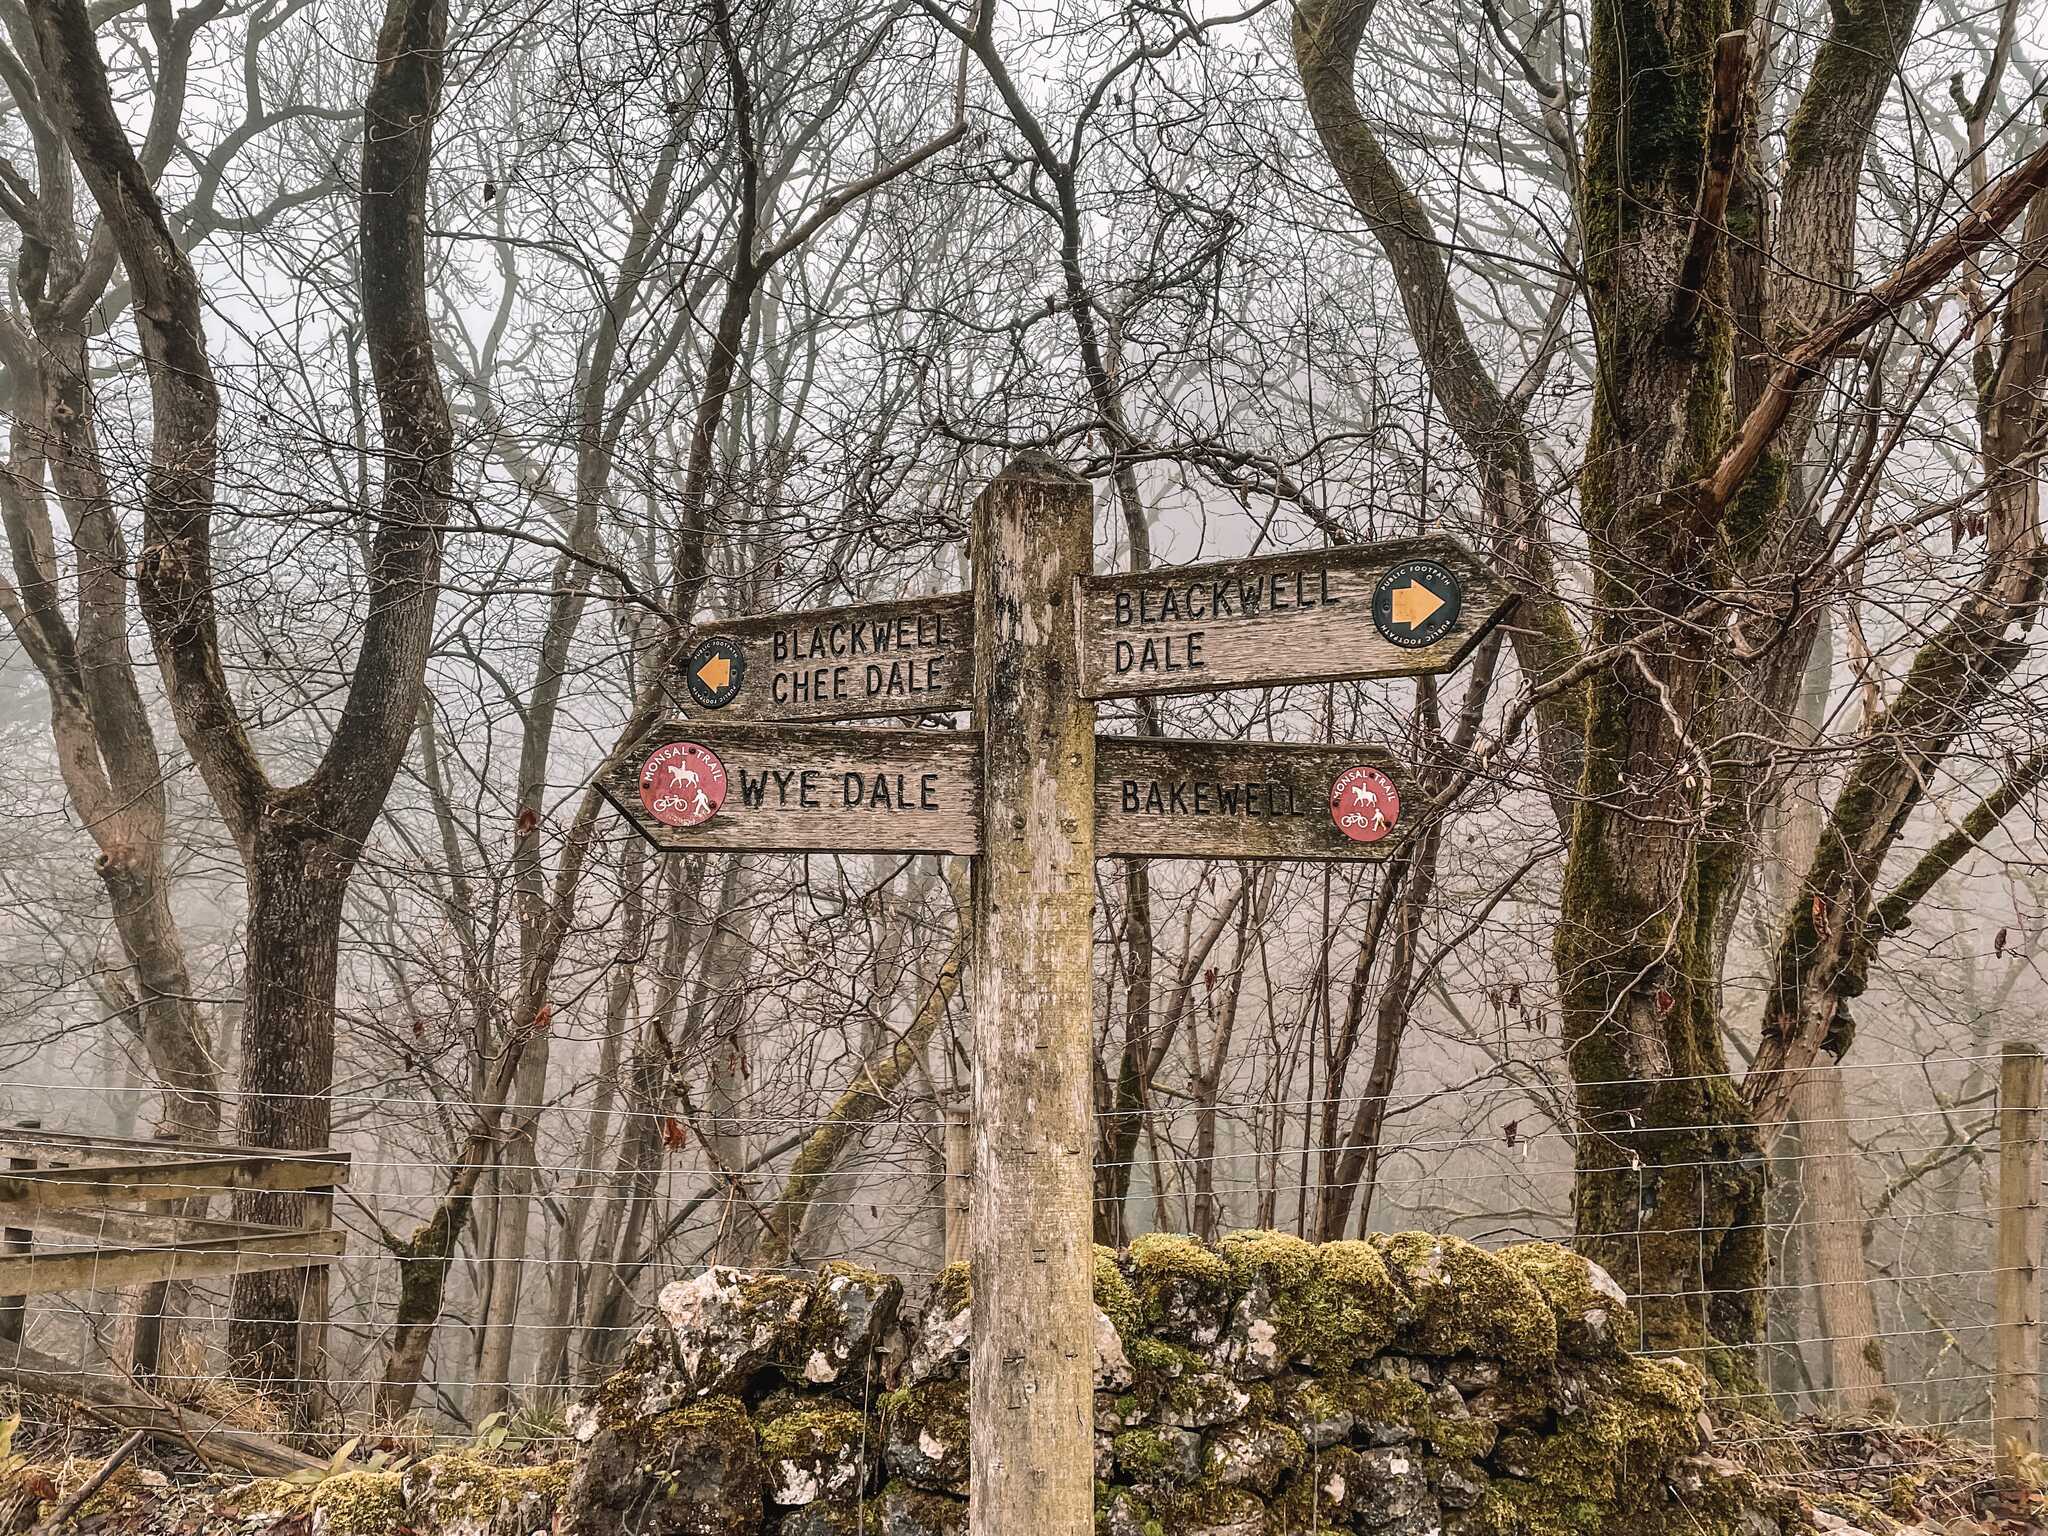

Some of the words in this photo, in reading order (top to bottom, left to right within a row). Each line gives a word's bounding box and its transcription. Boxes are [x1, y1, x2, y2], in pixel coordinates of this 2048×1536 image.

[1380, 569, 1406, 591] PUBLIC
[1409, 565, 1451, 586] FOOTPATH
[1115, 569, 1339, 626] BLACKWELL
[773, 613, 950, 661] BLACKWELL
[1380, 624, 1422, 645] FOOTPATH
[1426, 620, 1451, 642] PUBLIC
[694, 642, 711, 660] PUBLIC
[1115, 631, 1205, 674] DALE
[771, 666, 850, 704] CHEE
[866, 656, 945, 696] DALE
[644, 746, 688, 782] MONSAL
[696, 749, 723, 782] TRAIL
[739, 768, 820, 808] WYE
[843, 771, 940, 811] DALE
[1122, 779, 1304, 817] BAKEWELL
[1333, 770, 1368, 799] MONSAL
[1374, 773, 1396, 802] TRAIL
